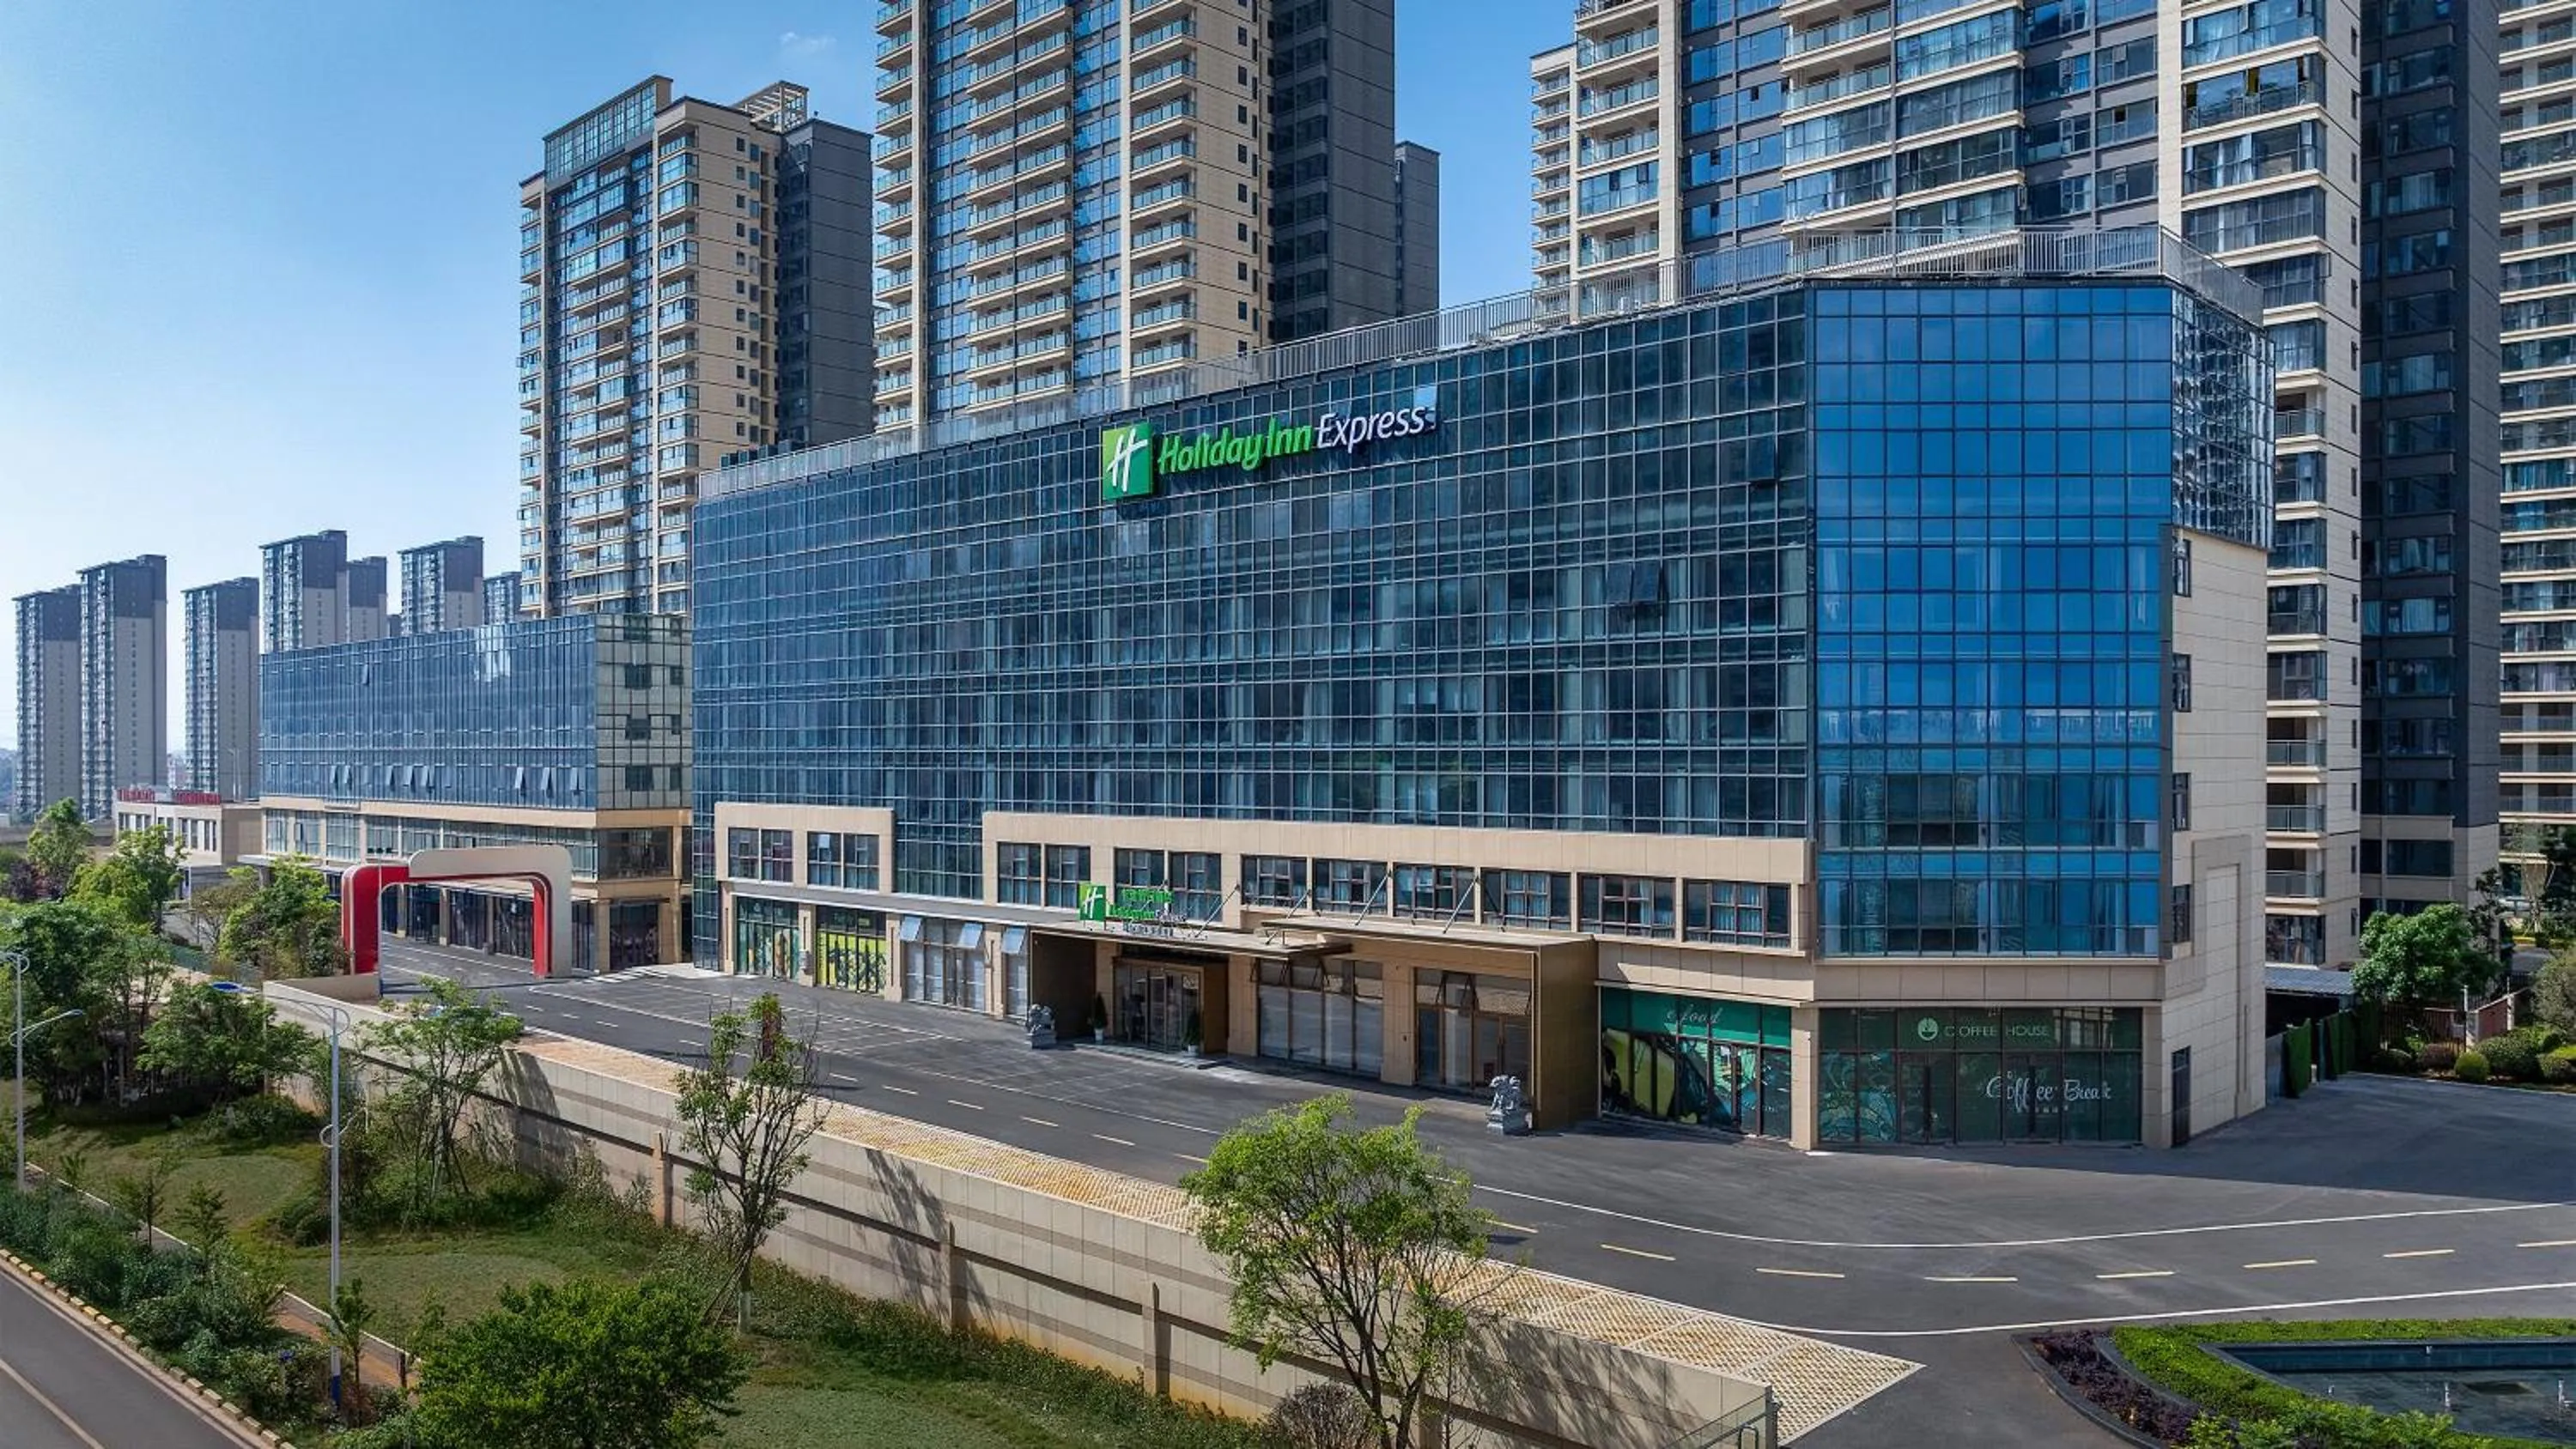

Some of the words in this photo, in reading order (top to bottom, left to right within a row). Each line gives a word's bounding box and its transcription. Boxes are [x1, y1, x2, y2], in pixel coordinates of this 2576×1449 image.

[1157, 427, 1263, 475] Holiday
[1265, 415, 1312, 458] Inn
[1317, 407, 1425, 454] Express
[1944, 1025, 1996, 1037] COFFEE
[2005, 1025, 2049, 1037] HOUSE
[1986, 1071, 2055, 1113] Coffee
